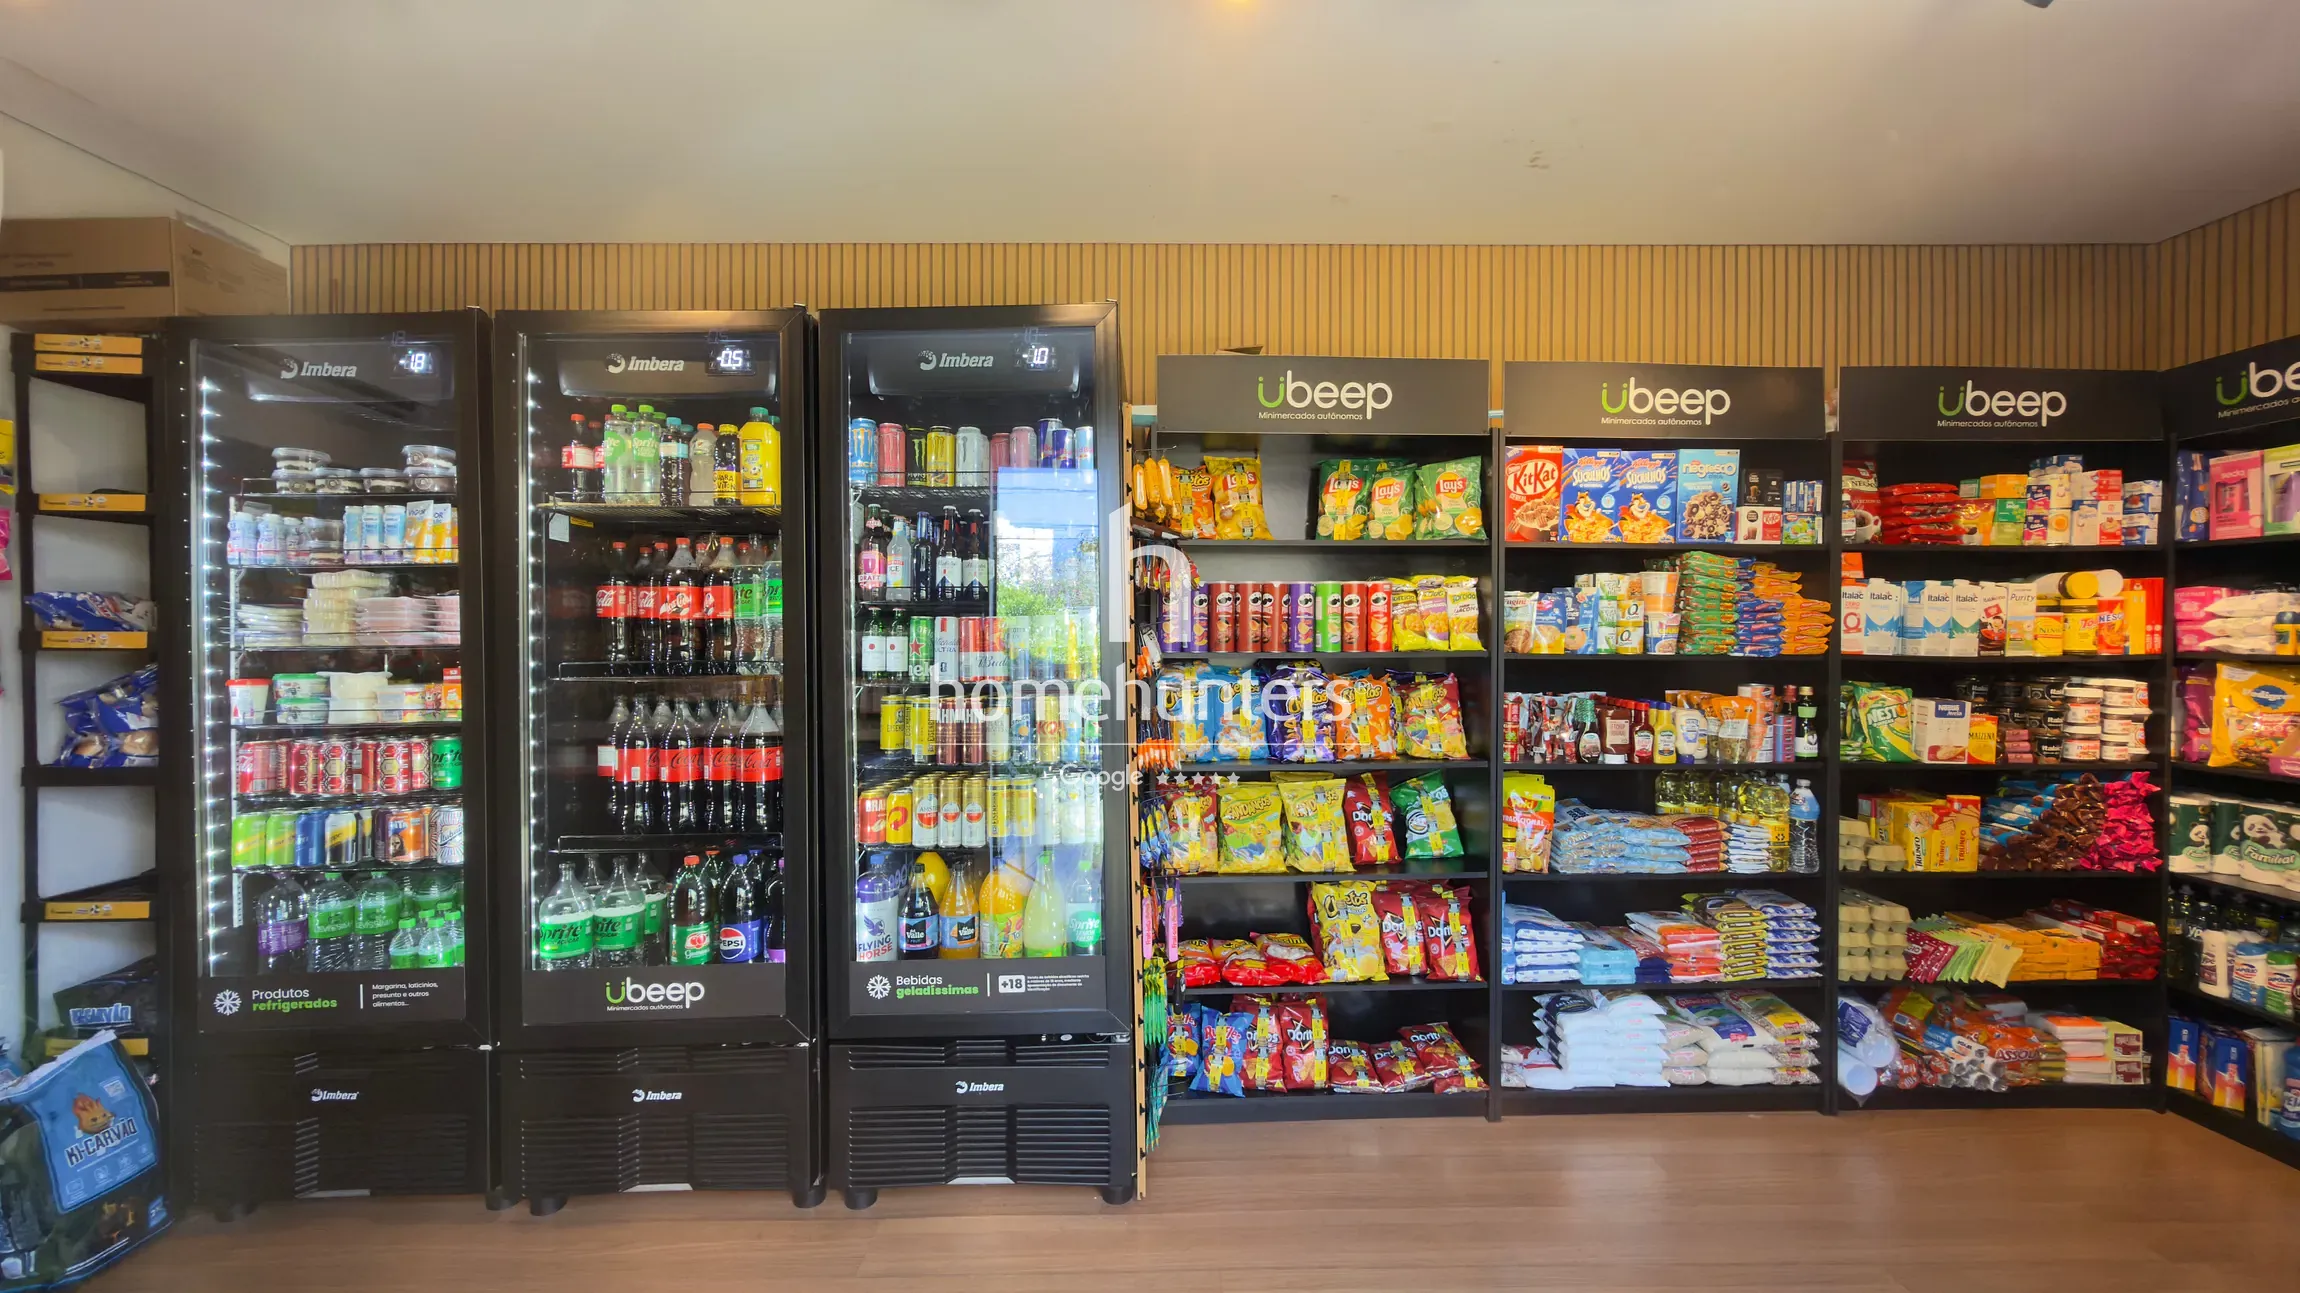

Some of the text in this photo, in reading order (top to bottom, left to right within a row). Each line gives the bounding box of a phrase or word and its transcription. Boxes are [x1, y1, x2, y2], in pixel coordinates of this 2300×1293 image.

[627, 355, 684, 372] Imbera
[939, 353, 994, 368] Imbera
[300, 361, 357, 377] Imbera
[2218, 397, 2289, 419] Minimercados
[1258, 412, 1364, 420] Minimercados autônomos
[1601, 416, 1702, 426] Minimercados autônomos
[1937, 419, 1992, 428] Minimercados
[1513, 462, 1556, 493] KitKat
[1374, 480, 1404, 500] Lay's
[1439, 478, 1465, 494] Lay's
[1841, 591, 1864, 600] Italac
[1869, 592, 1893, 601] Italac
[1927, 593, 1950, 602] Italac
[1956, 594, 1979, 602] Italac
[2010, 593, 2036, 603] Purity
[1226, 796, 1272, 821] FANDANGOS
[1915, 836, 1923, 867] TRIUNFO
[1959, 830, 1967, 861] TRIUNFO
[2244, 845, 2296, 865] Familiar
[1069, 917, 1100, 931] Sprite
[540, 924, 583, 946] Sprite
[858, 934, 891, 952] FLYING
[859, 945, 893, 961] HORSE
[896, 975, 943, 986] Bebidas
[1001, 978, 1023, 989] +18
[252, 988, 310, 1000] Produtos
[372, 992, 402, 1000] presunto
[408, 990, 430, 998] outros
[896, 985, 979, 999] geladíssimas
[252, 998, 338, 1013] refrigerados
[650, 1003, 683, 1011] autônomos
[969, 1083, 1005, 1092] Imbera
[322, 1090, 359, 1101] Imbera
[646, 1091, 683, 1101] Imbera
[65, 1117, 138, 1168] KI-CARVÃO
